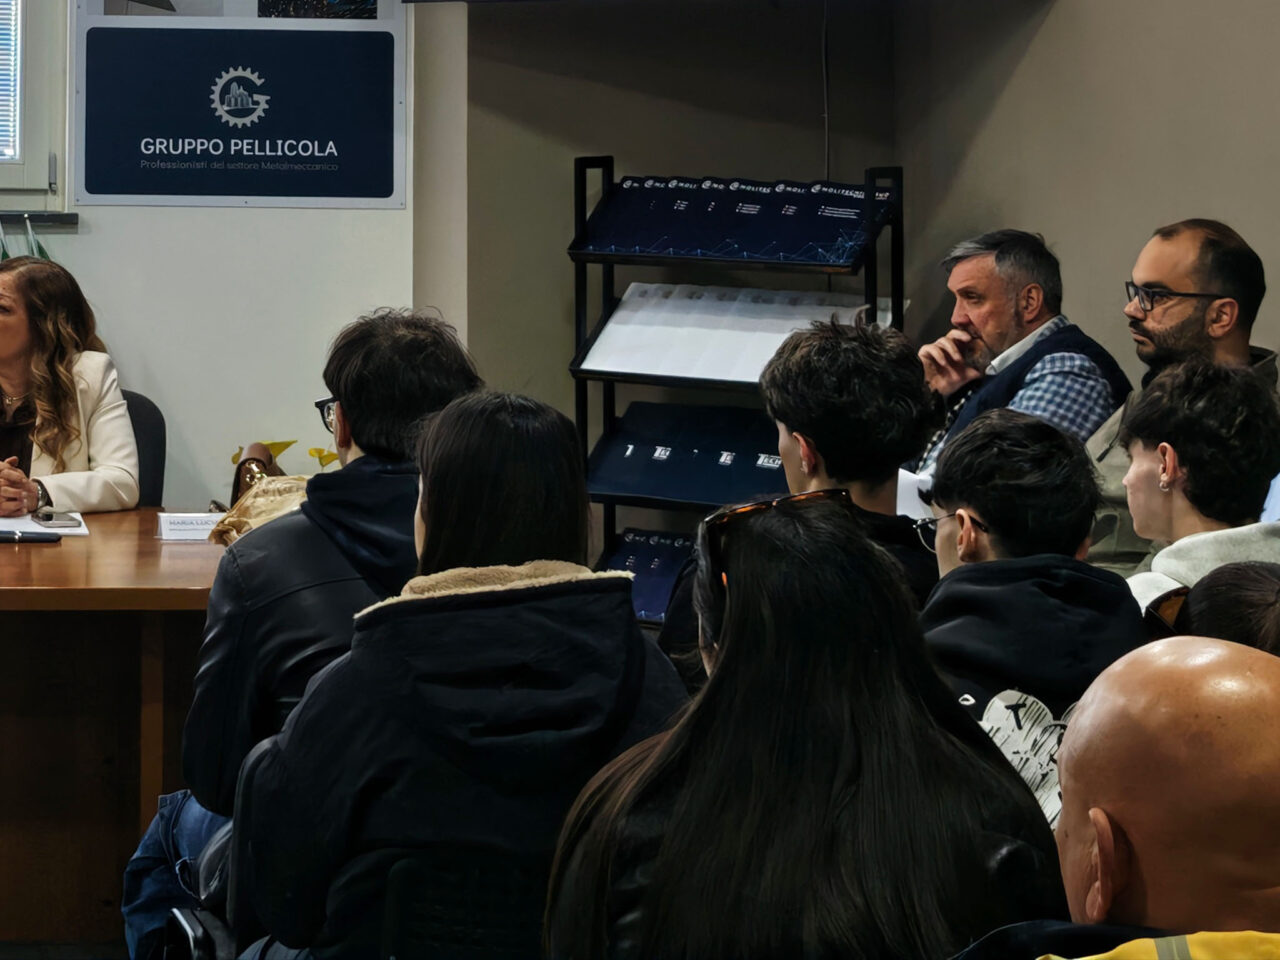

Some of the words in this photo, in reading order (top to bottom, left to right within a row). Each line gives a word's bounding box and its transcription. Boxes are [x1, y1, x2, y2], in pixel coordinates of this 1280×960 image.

[140, 138, 224, 155] GRUPPO
[230, 139, 338, 157] PELLICOLA
[140, 159, 208, 169] Professionisti
[210, 161, 225, 170] del
